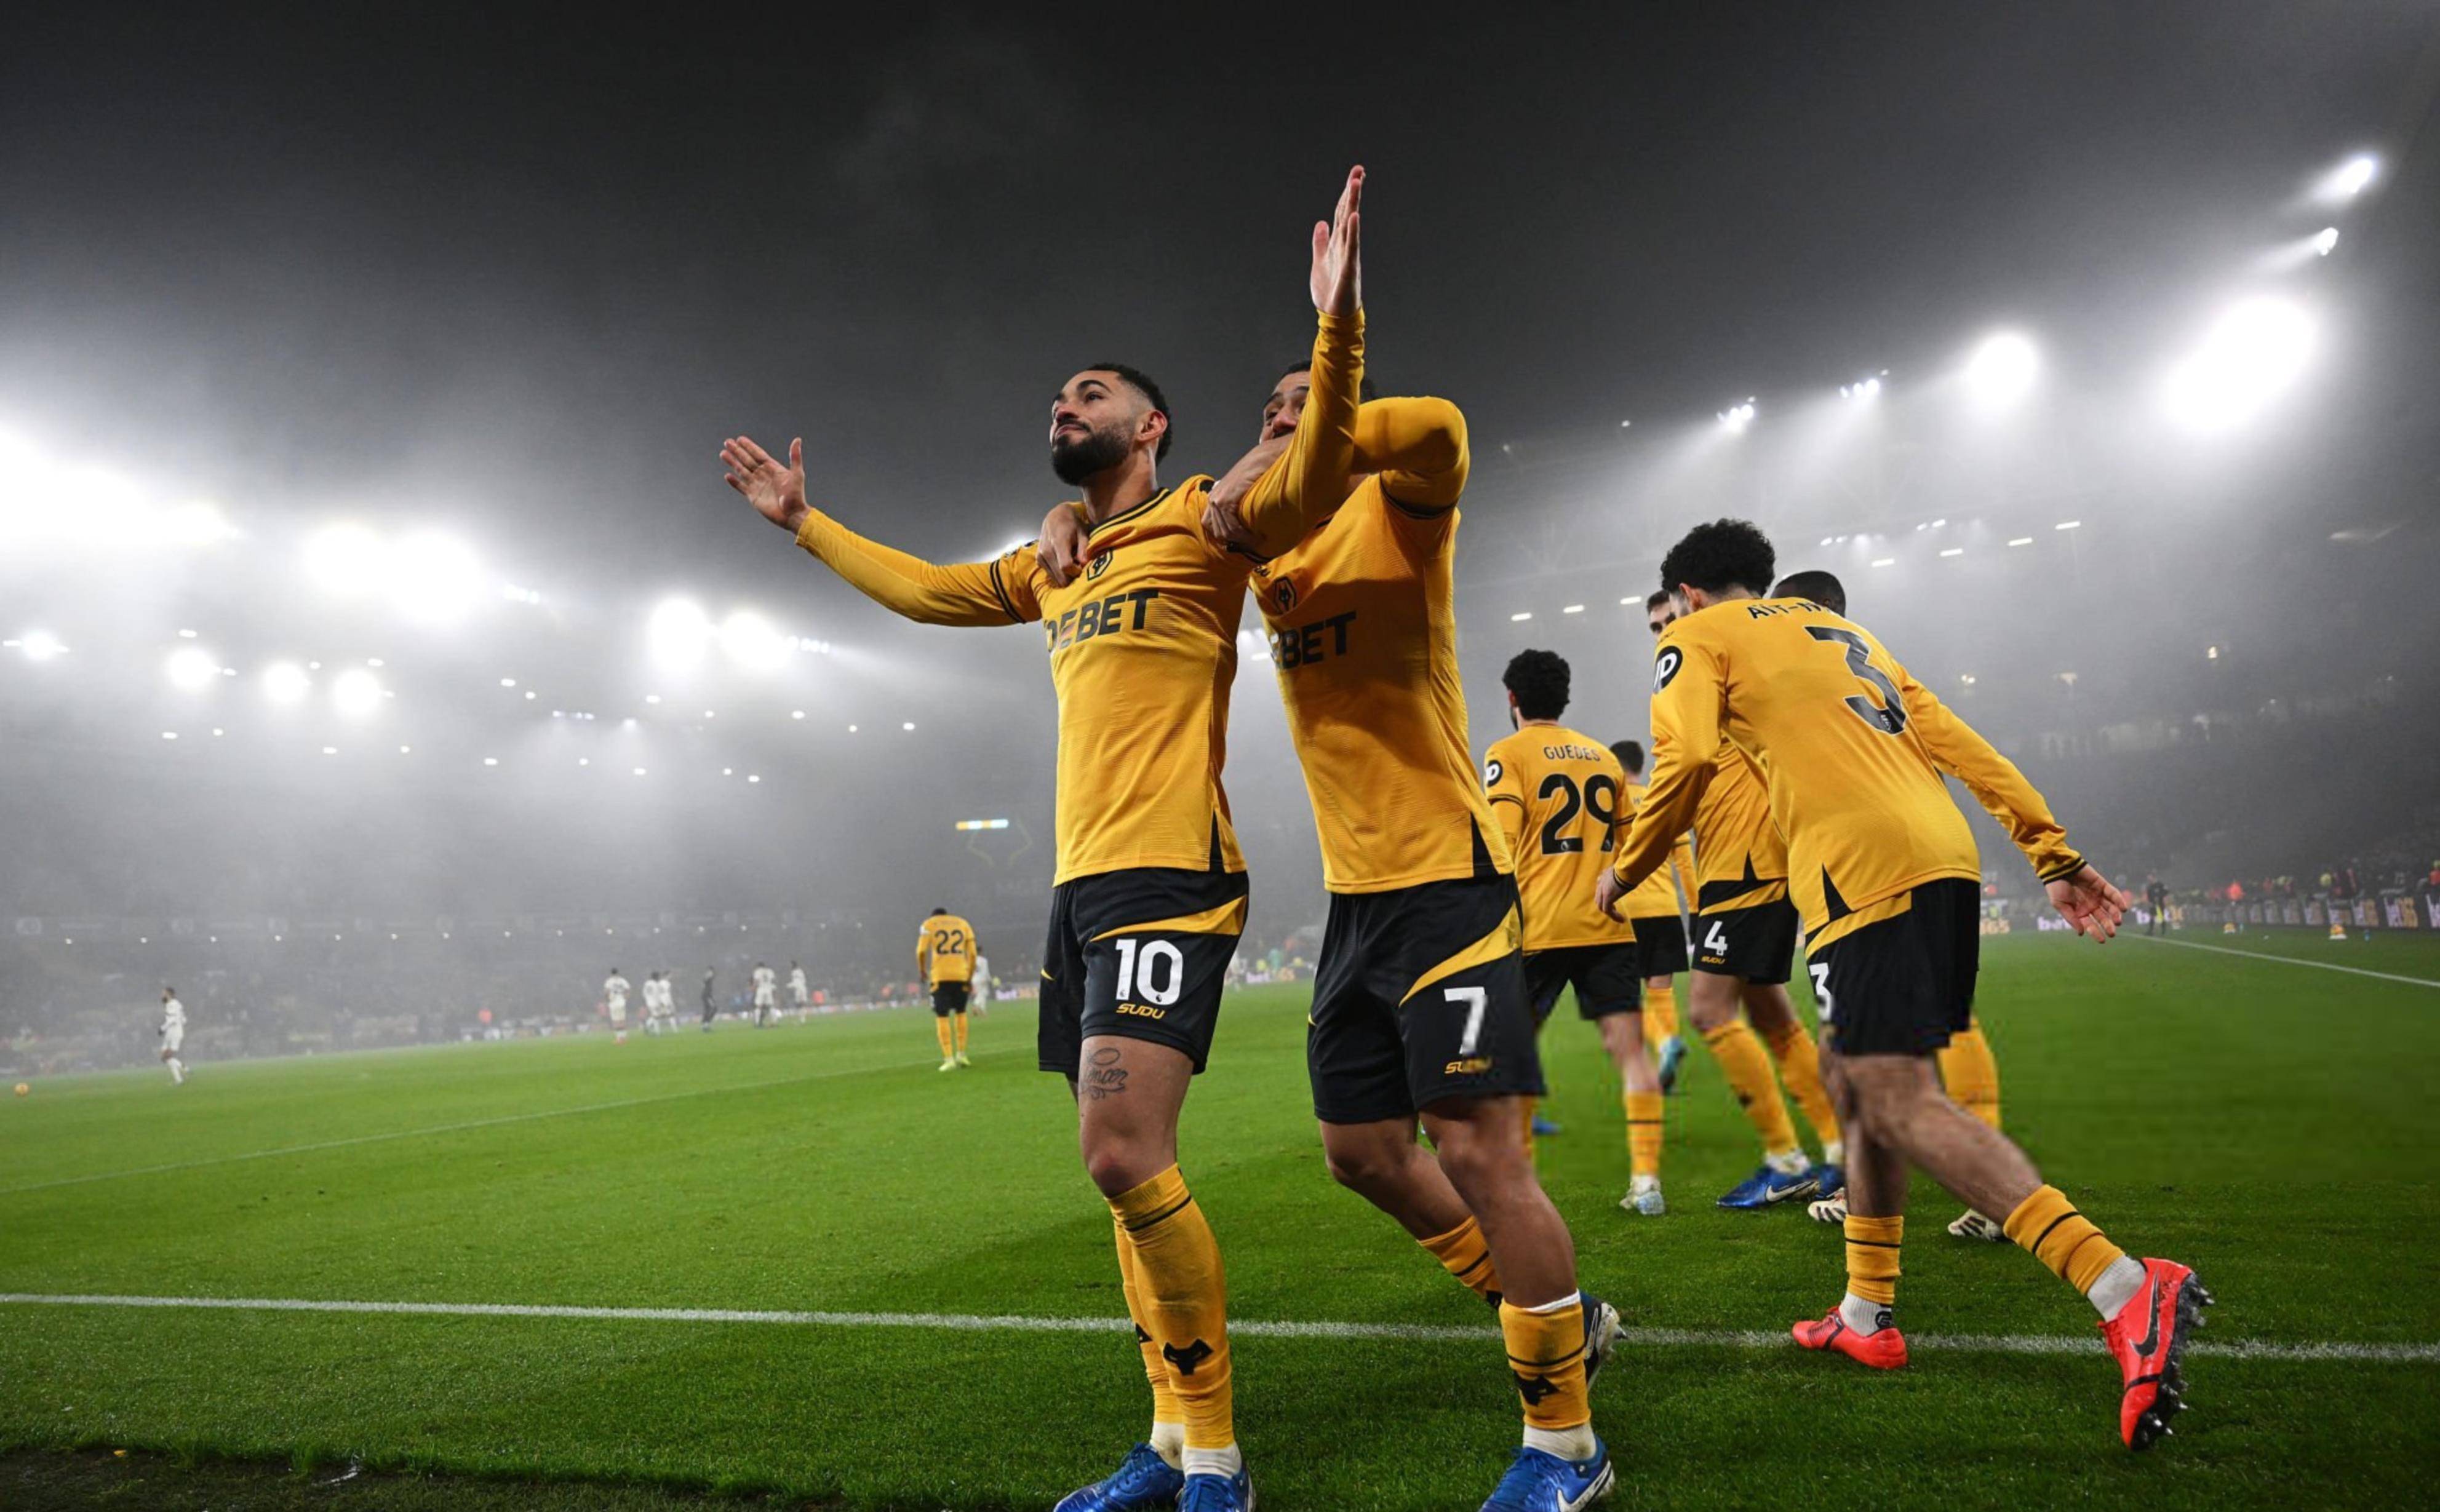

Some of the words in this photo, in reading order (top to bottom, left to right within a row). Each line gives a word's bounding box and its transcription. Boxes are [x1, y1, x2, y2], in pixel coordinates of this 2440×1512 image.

[1271, 611, 1357, 669] BET
[1804, 626, 1907, 734] 3
[1544, 745, 1601, 762] GUEDES
[1538, 773, 1617, 855] 29
[935, 929, 963, 954] 22
[1700, 956, 1725, 965] SUDU
[1704, 920, 1728, 956] 4
[1115, 939, 1183, 1005] 10
[1809, 962, 1833, 1021] 3
[1116, 1003, 1165, 1019] SUDU
[1444, 987, 1488, 1054] 7
